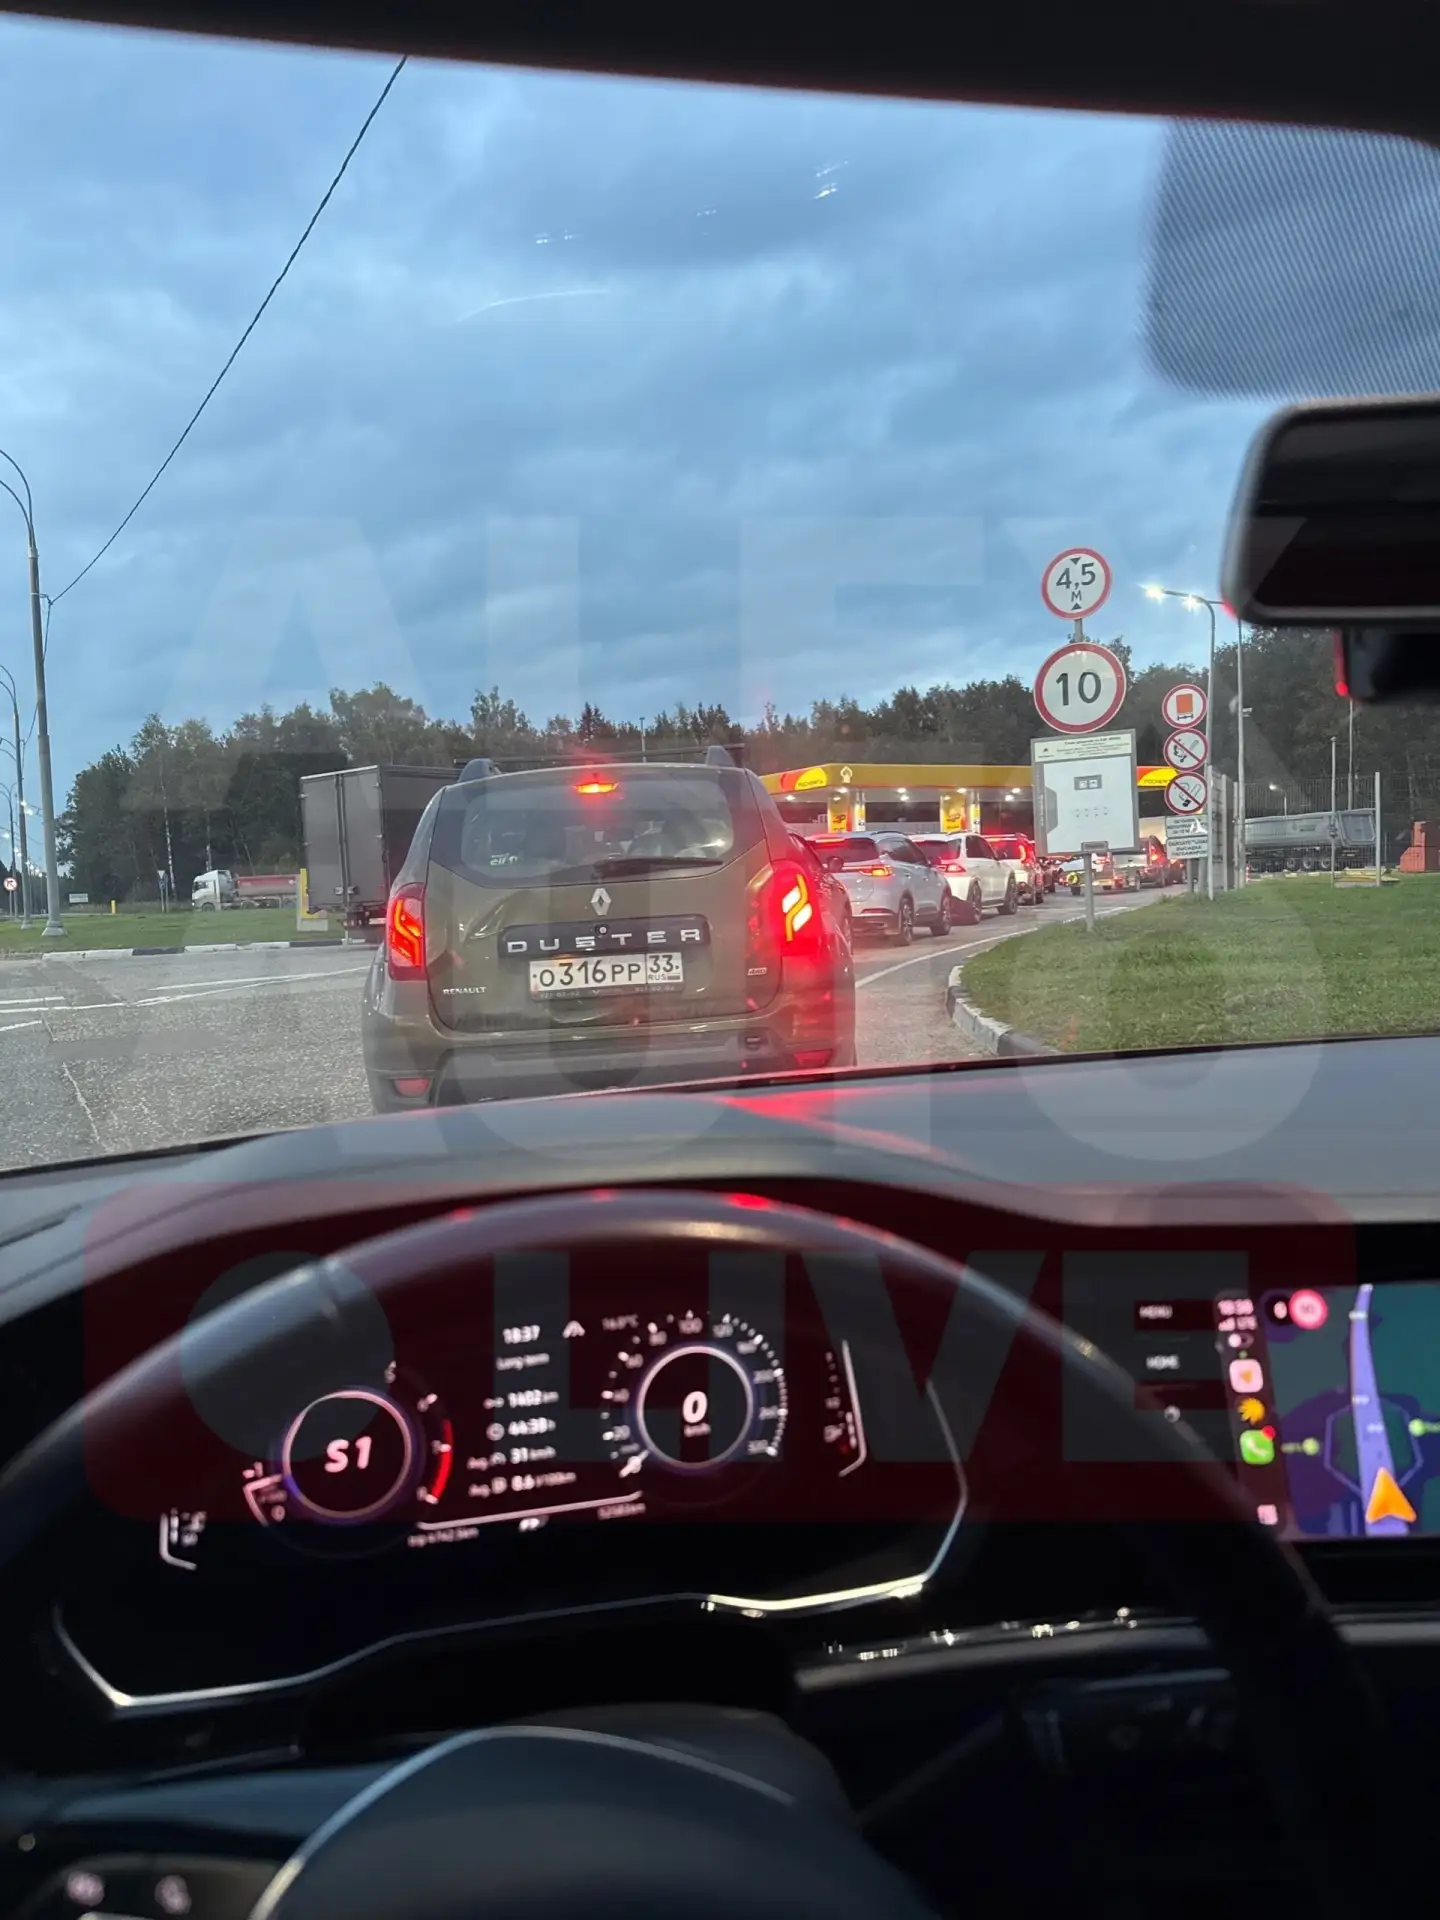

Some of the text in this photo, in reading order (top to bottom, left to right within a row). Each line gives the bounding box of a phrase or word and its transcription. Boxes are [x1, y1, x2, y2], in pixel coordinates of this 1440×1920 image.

[1056, 562, 1096, 590] 4,5
[1056, 671, 1102, 706] 10
[507, 929, 700, 953] DUSTER
[649, 955, 674, 973] 33
[442, 986, 487, 995] RENAULT
[682, 1390, 708, 1423] 0
